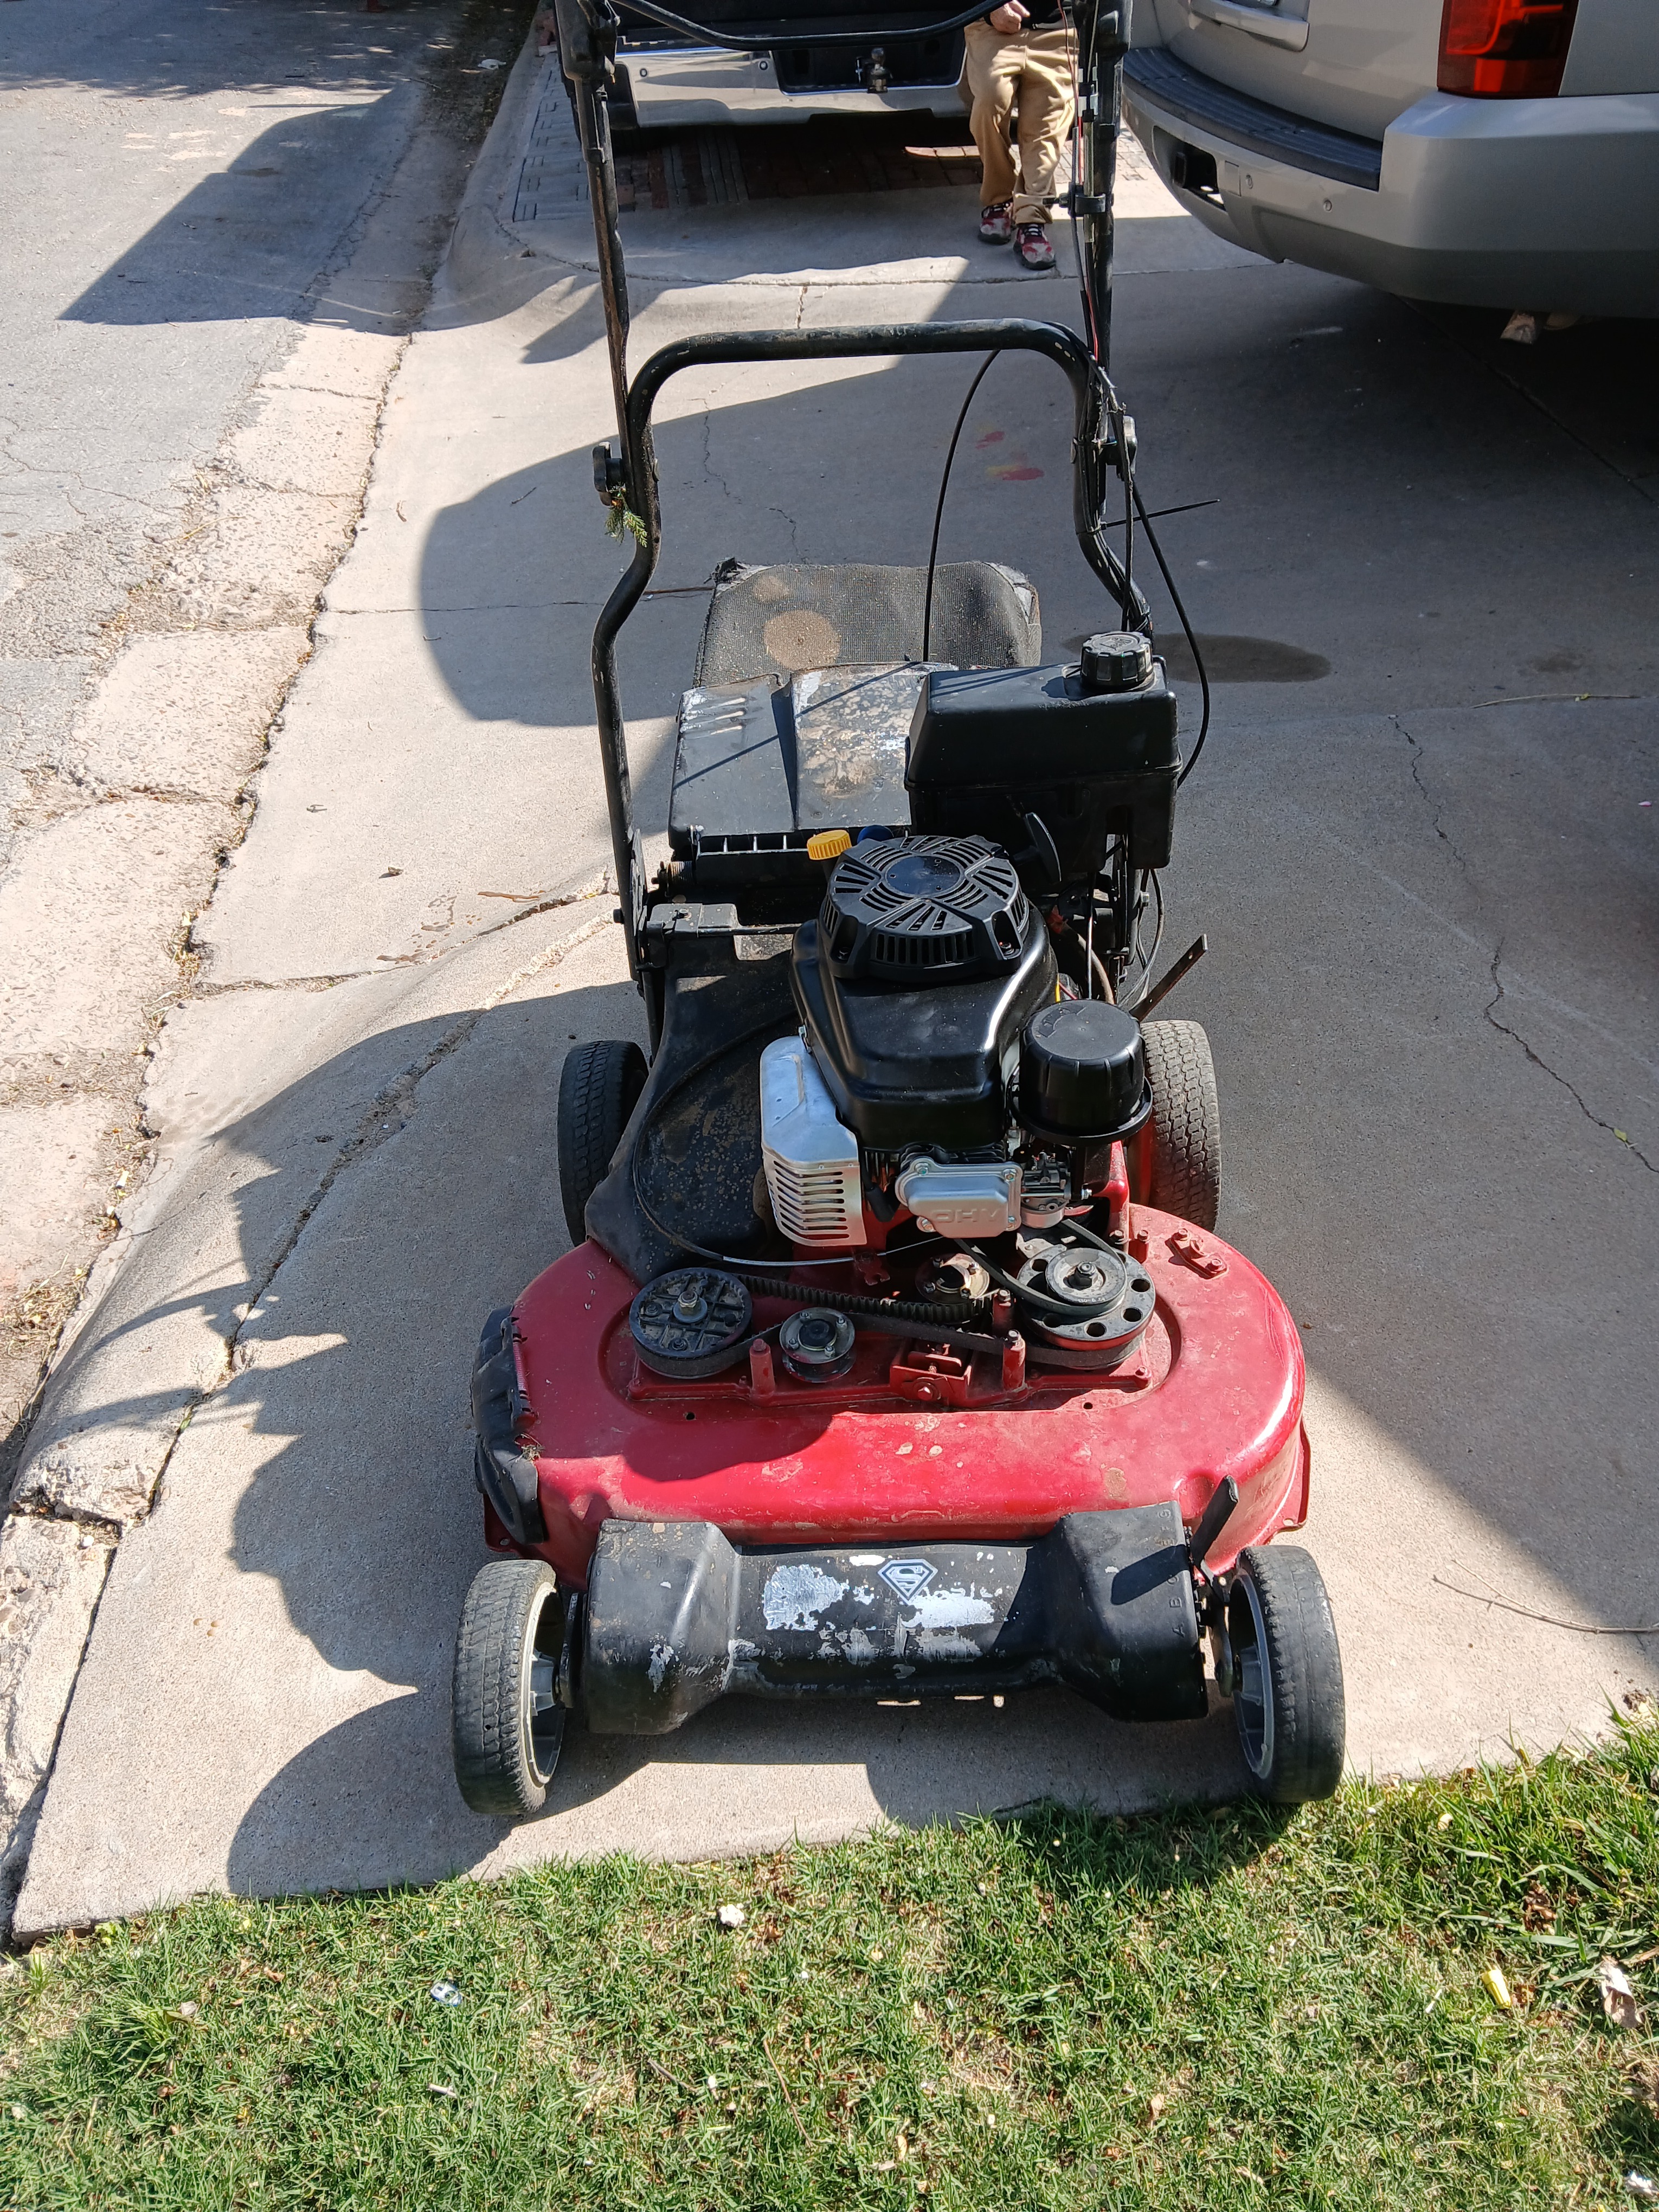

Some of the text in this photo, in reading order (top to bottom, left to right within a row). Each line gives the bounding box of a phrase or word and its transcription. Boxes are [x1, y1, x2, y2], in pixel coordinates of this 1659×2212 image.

[931, 1208, 1002, 1223] OHV
[1169, 1597, 1183, 1609] B
[1173, 1623, 1186, 1638] A
